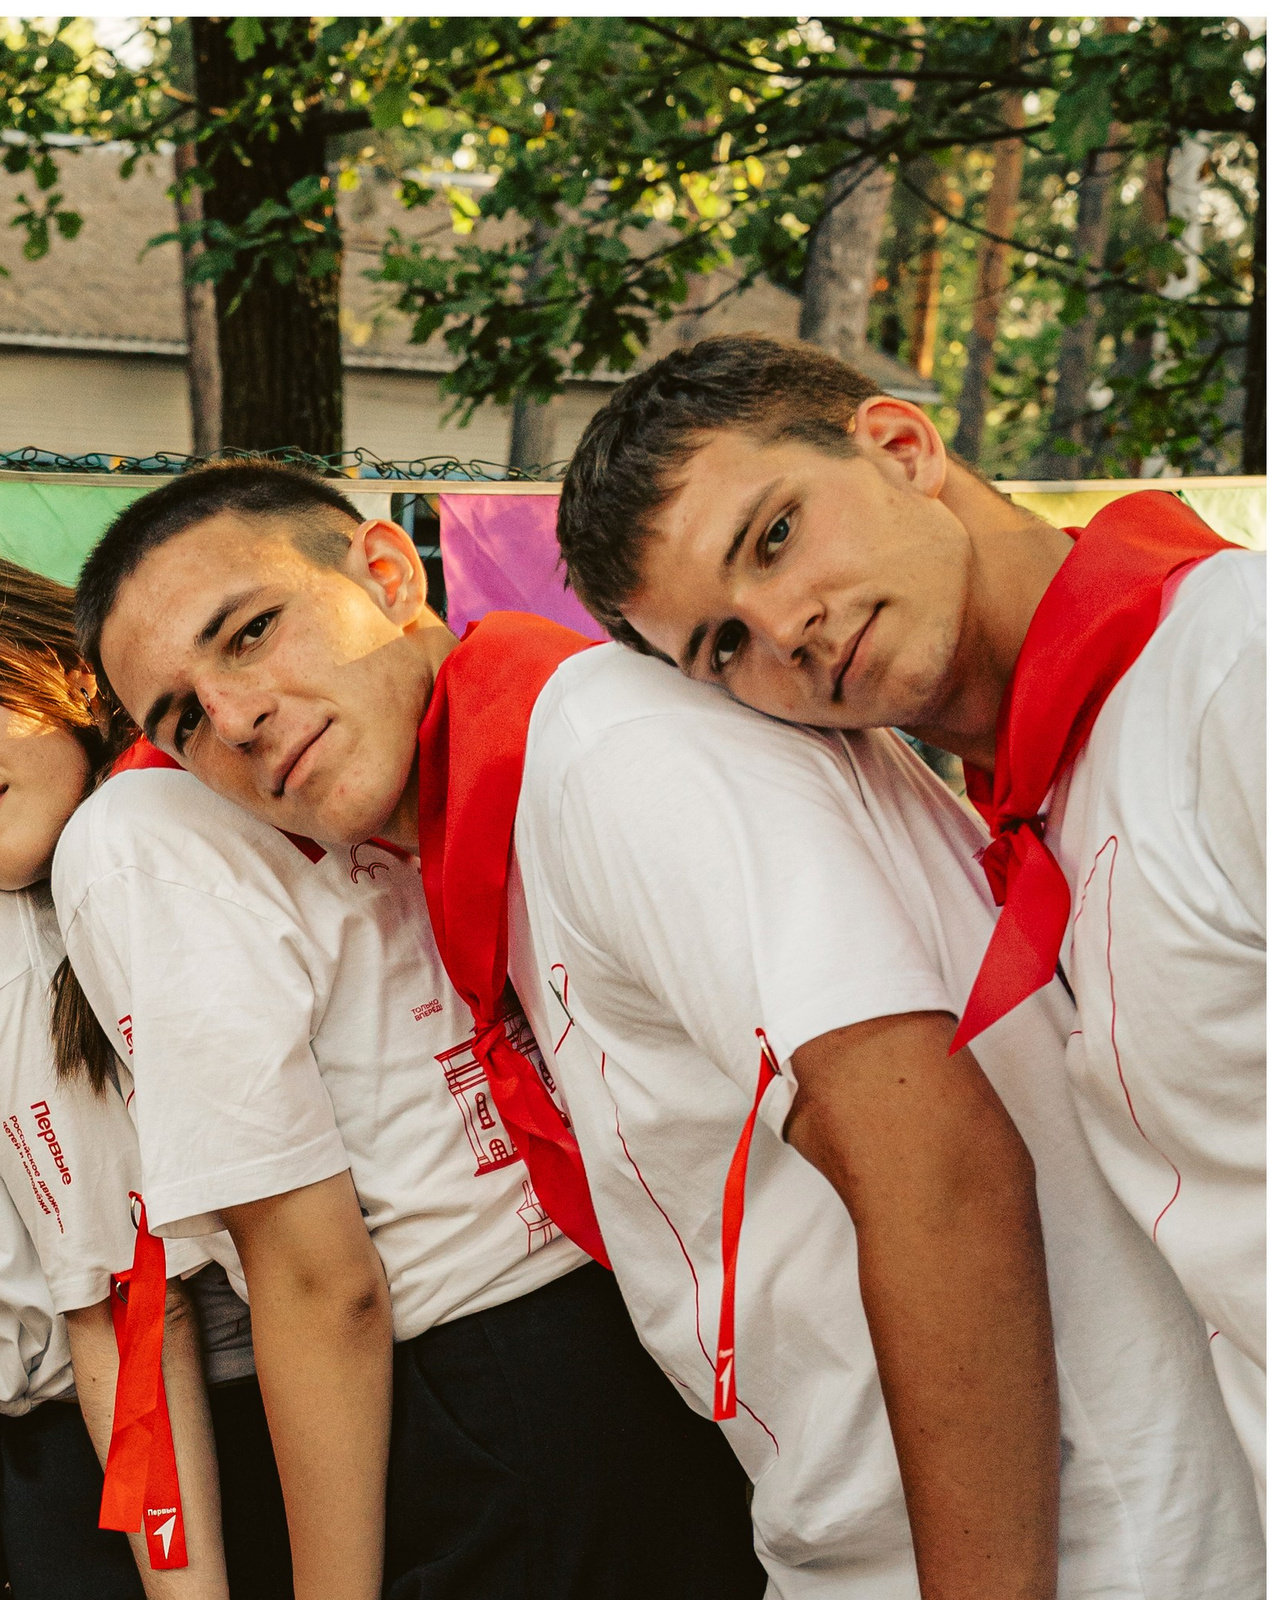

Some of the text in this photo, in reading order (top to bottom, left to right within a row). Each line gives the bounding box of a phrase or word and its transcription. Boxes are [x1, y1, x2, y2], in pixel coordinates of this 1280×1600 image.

[411, 999, 439, 1015] ТОЛЬКО
[9, 1115, 40, 1177] Российское
[30, 1100, 72, 1185] Первые
[147, 1507, 177, 1517] Первые
